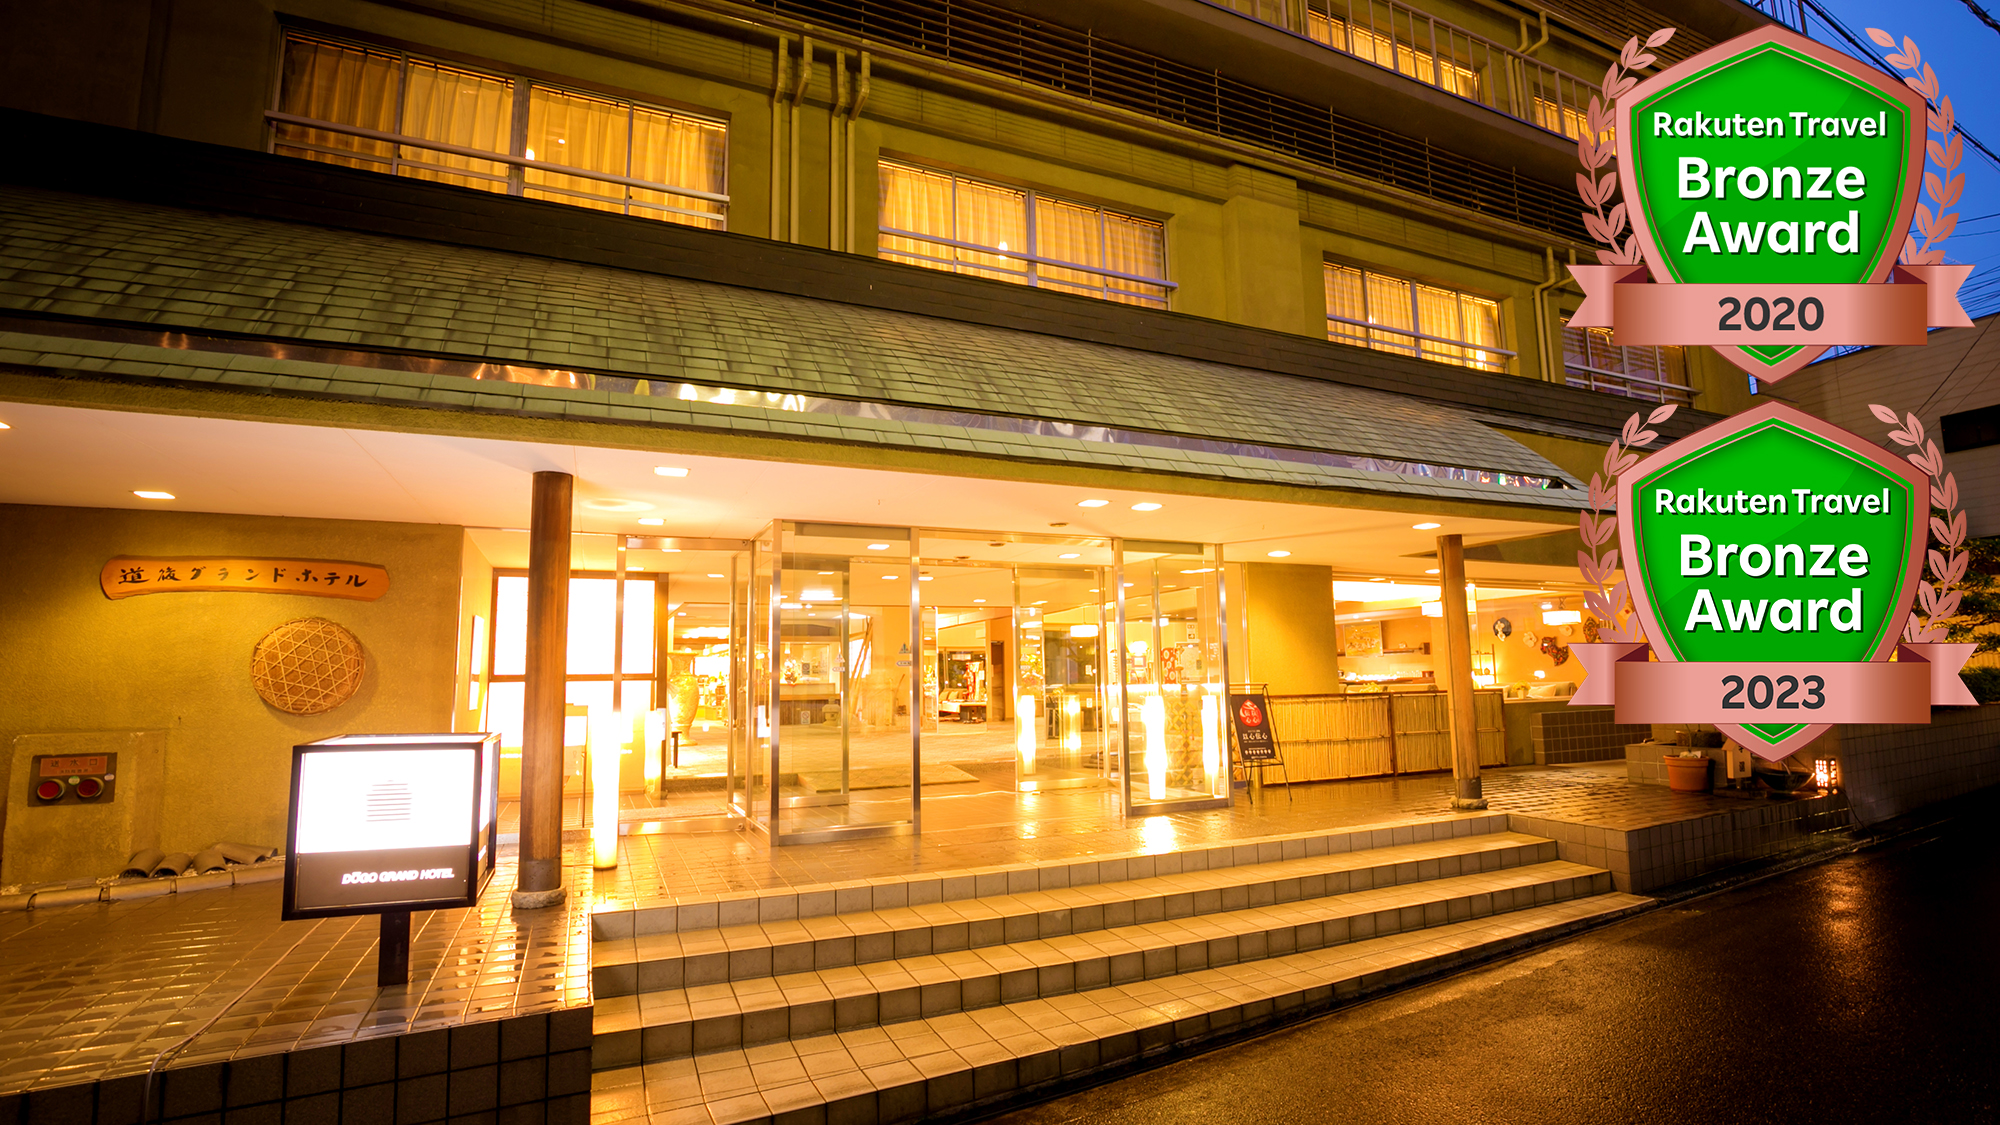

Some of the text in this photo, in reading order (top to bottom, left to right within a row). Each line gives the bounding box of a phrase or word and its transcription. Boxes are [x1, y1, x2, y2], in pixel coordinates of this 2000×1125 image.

[118, 565, 369, 588] 道後グランドホテル
[379, 869, 418, 882] GRAND
[420, 868, 455, 881] HOTEL
